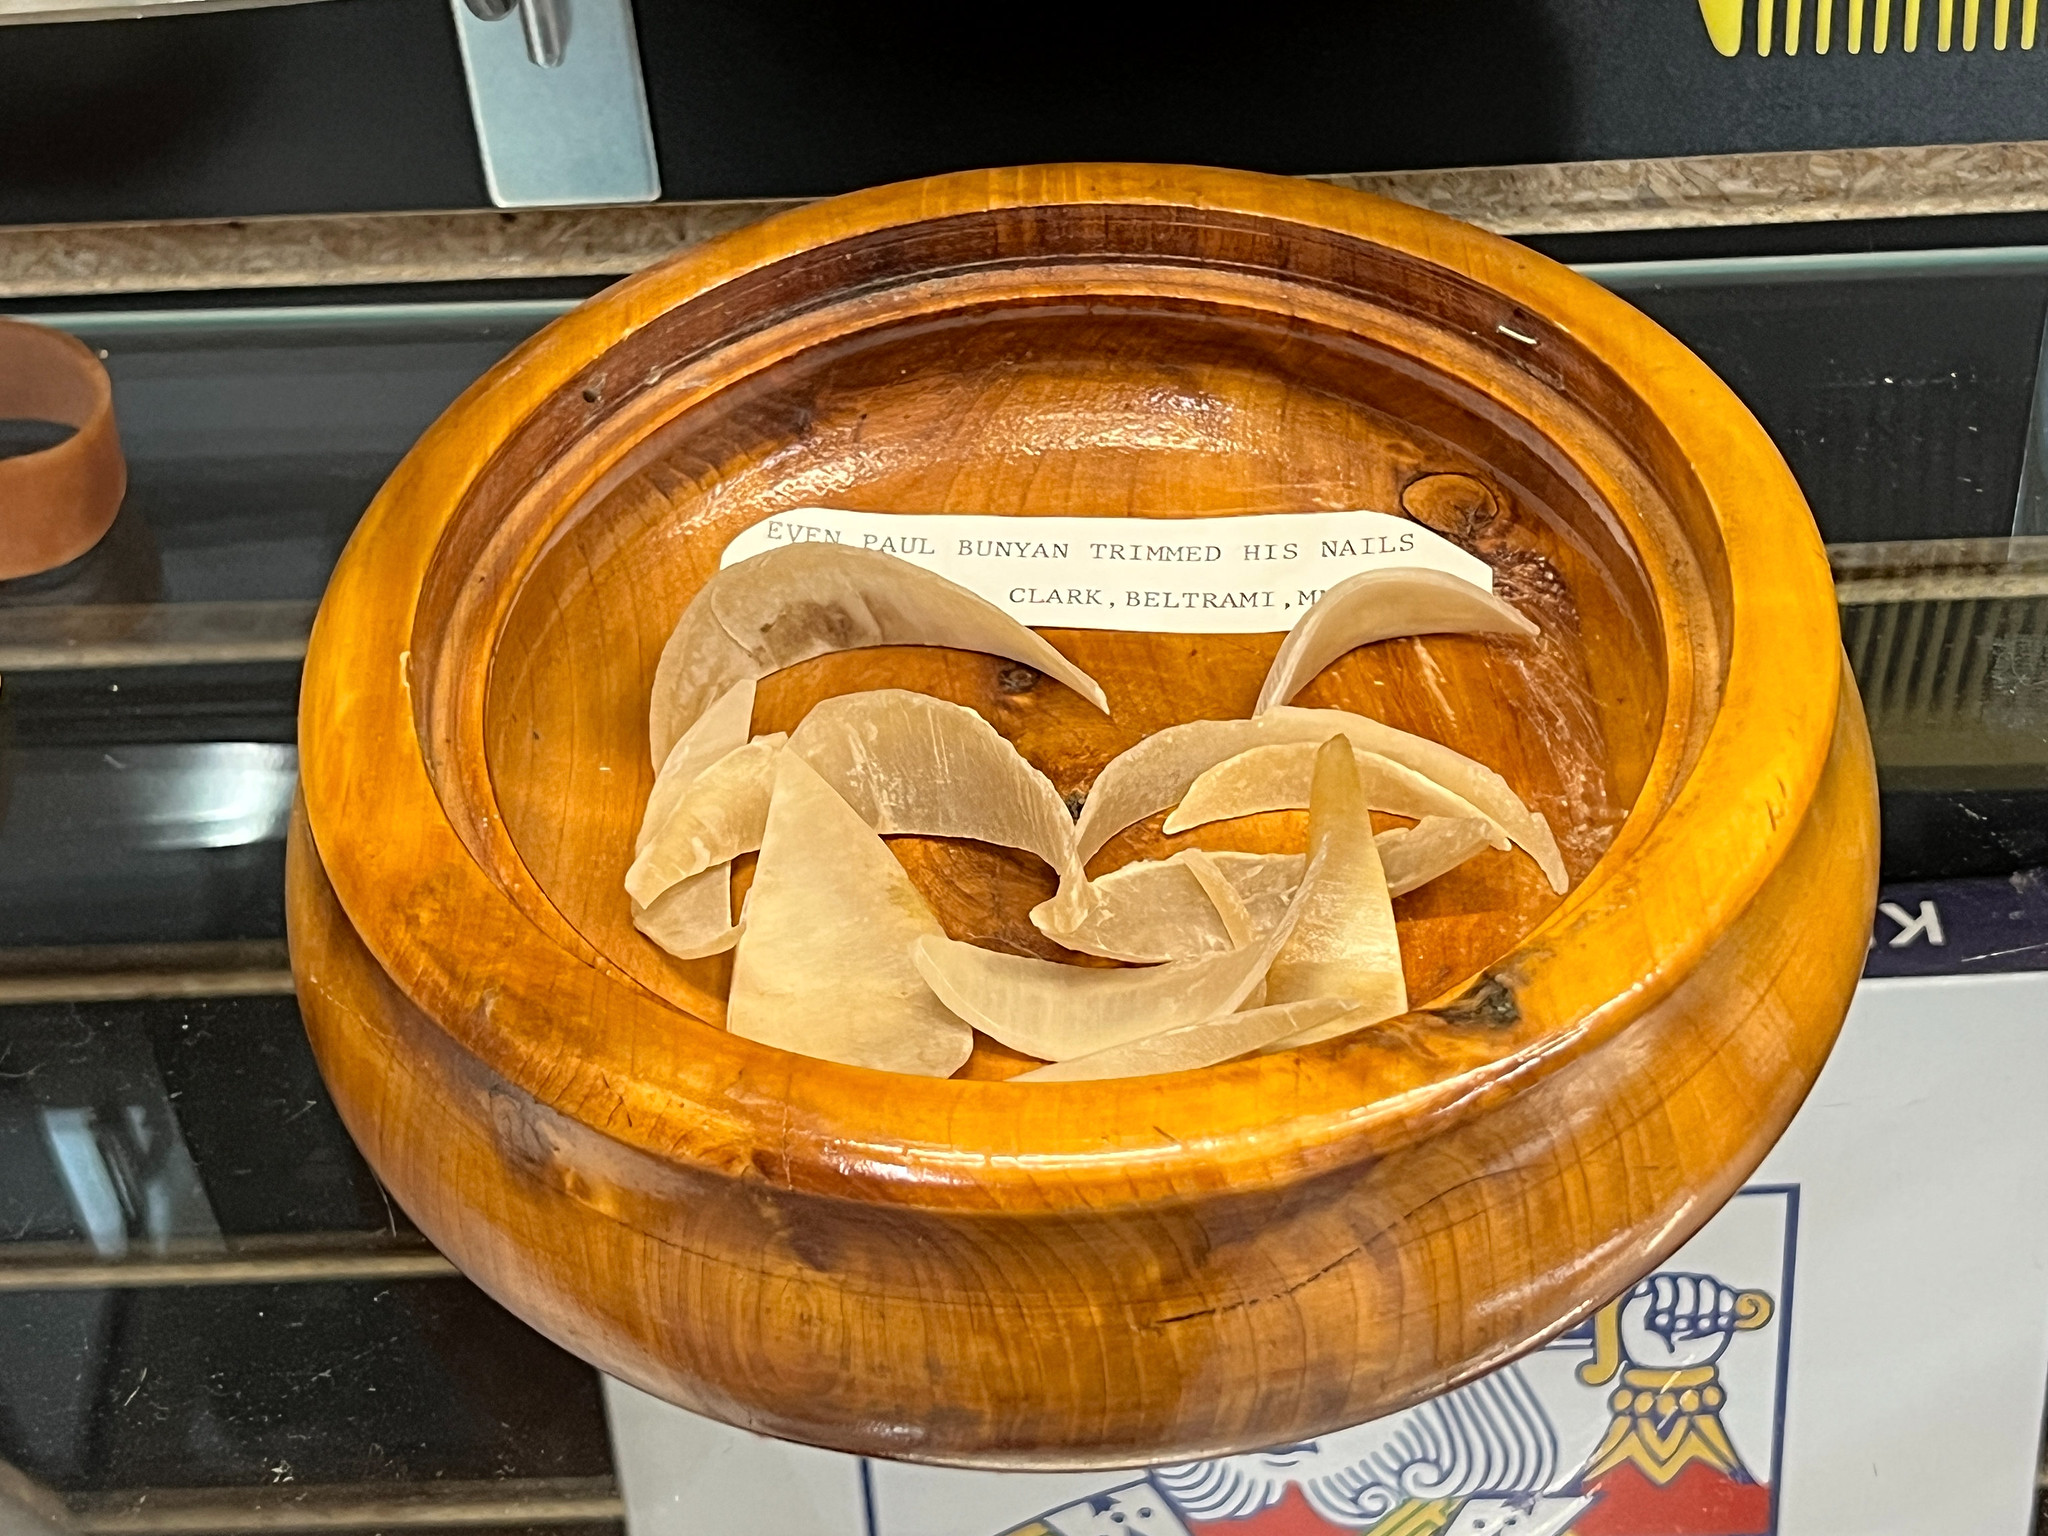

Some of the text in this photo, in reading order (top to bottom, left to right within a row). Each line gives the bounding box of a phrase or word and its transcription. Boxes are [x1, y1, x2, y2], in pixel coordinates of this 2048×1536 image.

[767, 521, 1415, 562] EVEN PAUL BUNYAN TRIMMED HIS NAILS
